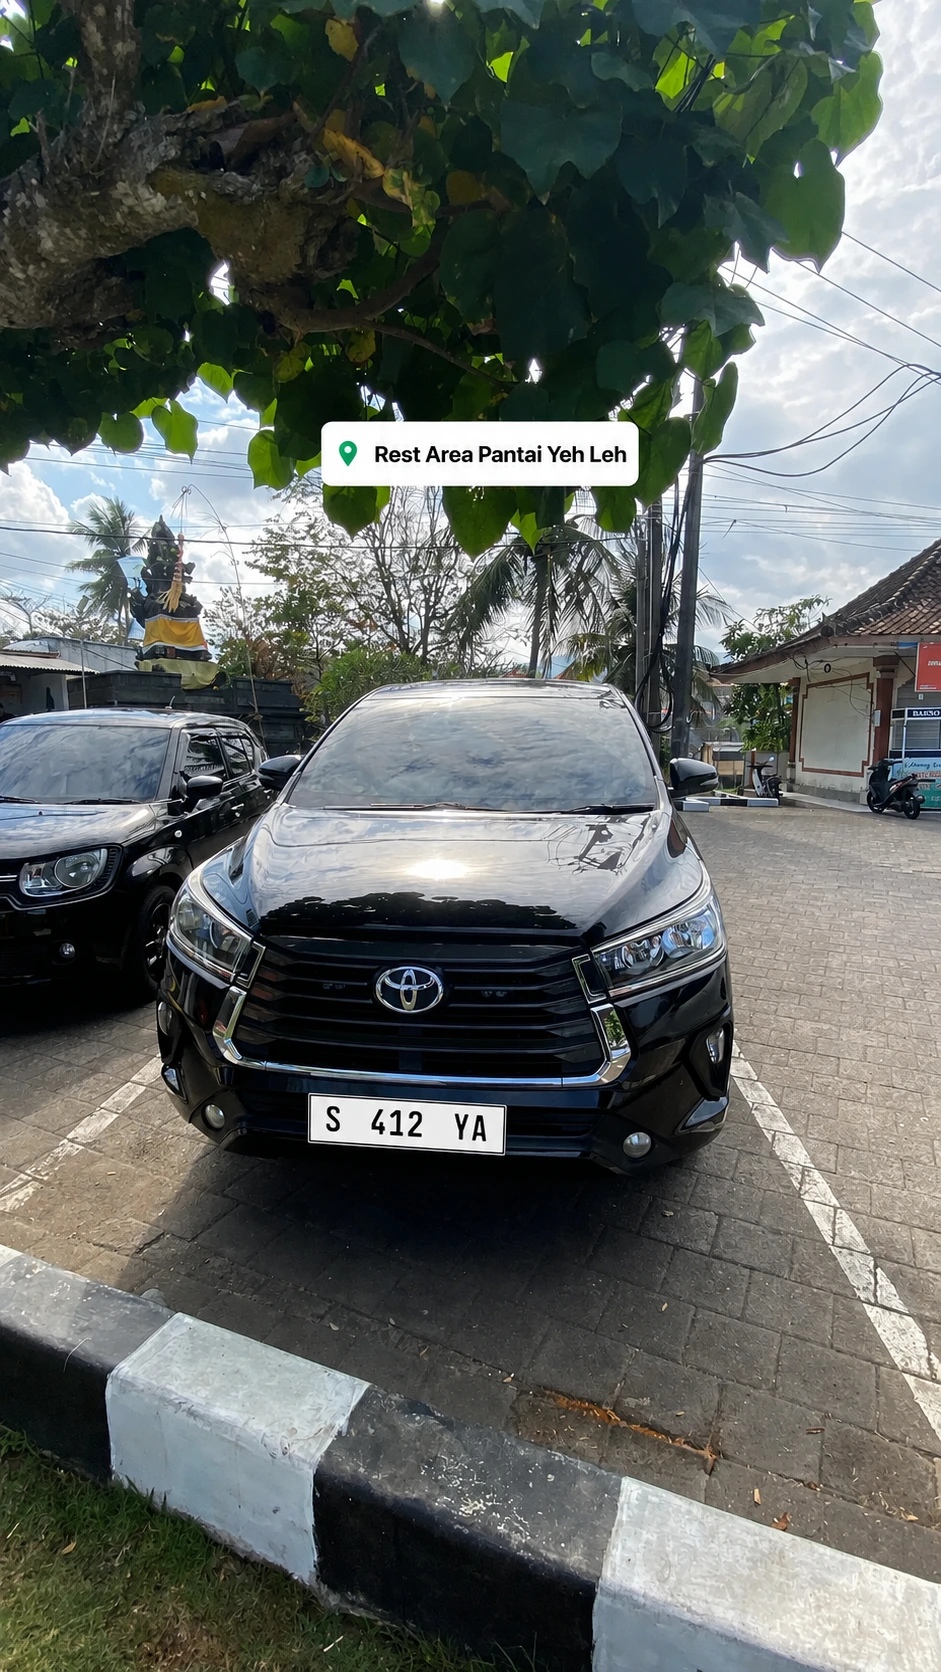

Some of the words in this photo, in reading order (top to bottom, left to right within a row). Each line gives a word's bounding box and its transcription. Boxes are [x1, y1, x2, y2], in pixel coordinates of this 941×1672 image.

[325, 1105, 341, 1133] S
[371, 1108, 423, 1138] 412
[454, 1113, 487, 1142] YA
